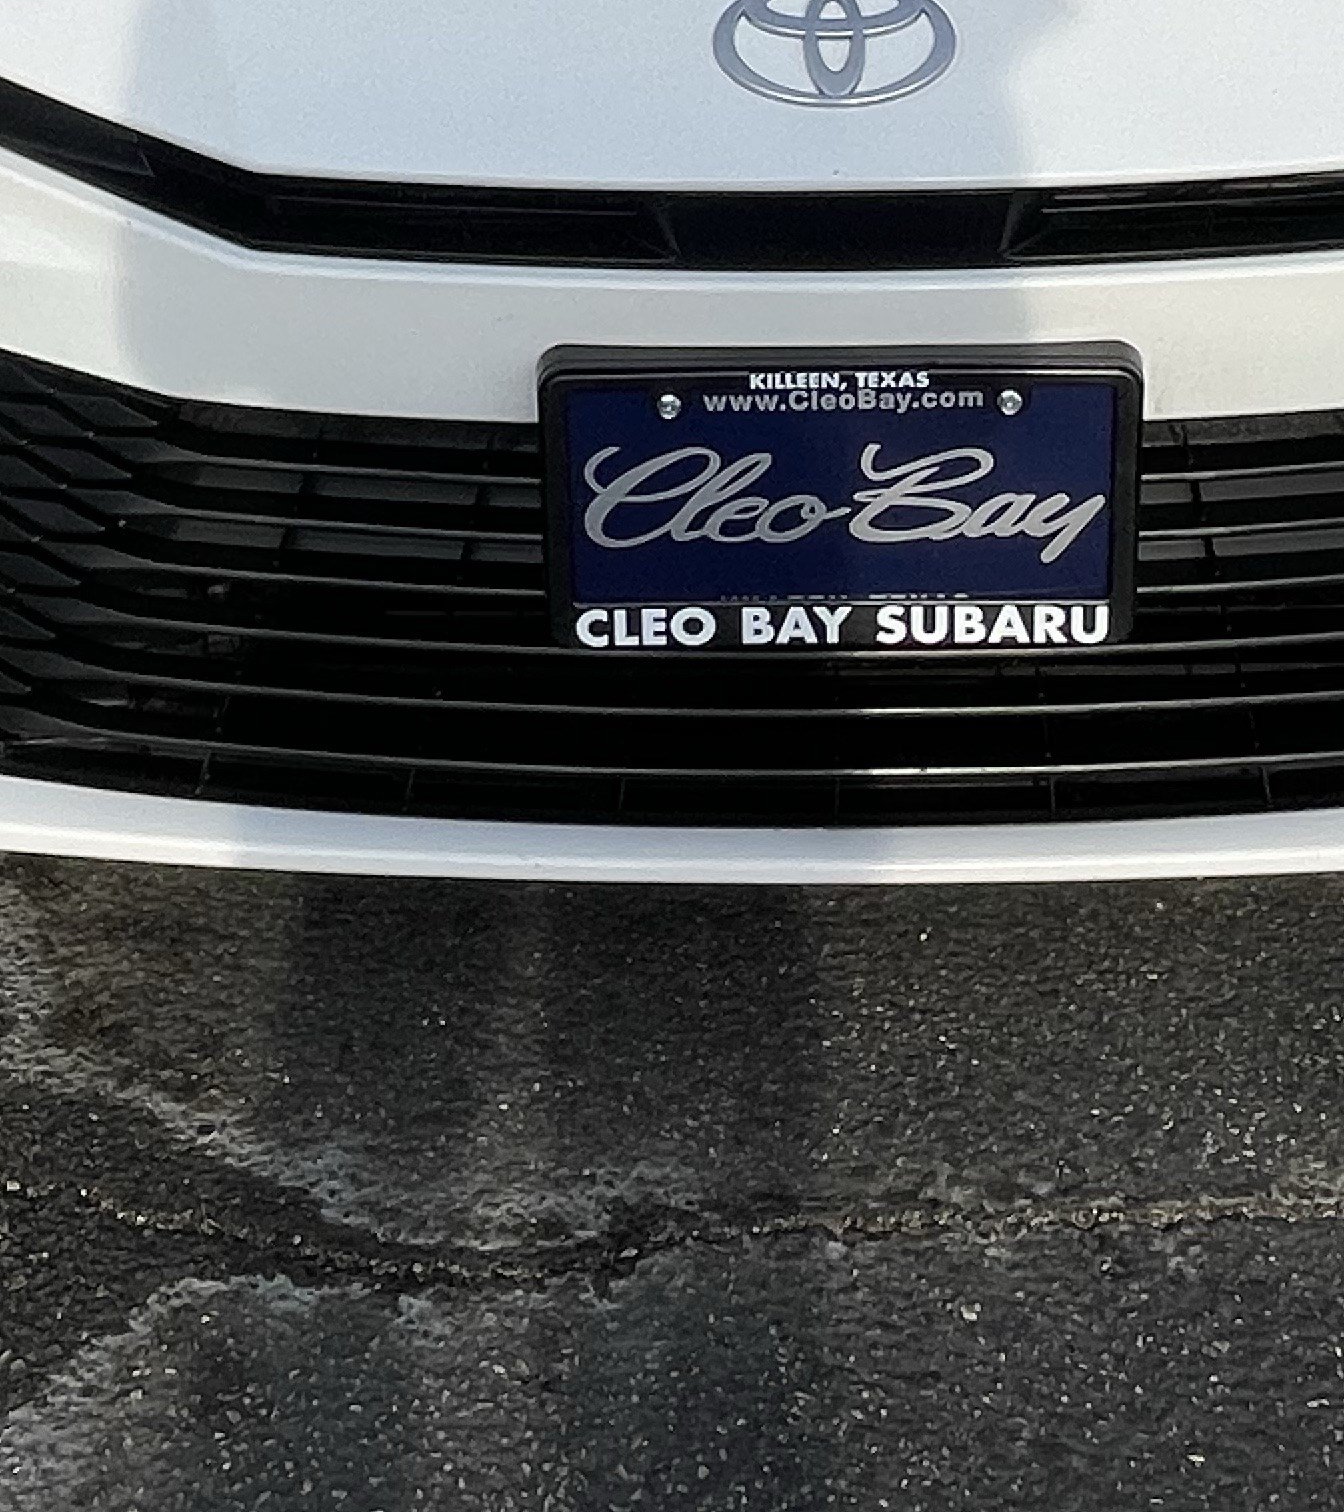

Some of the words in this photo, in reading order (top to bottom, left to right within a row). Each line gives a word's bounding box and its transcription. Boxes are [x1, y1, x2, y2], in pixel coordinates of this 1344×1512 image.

[749, 372, 848, 391] KILLEEN,
[855, 371, 930, 388] TEXAS
[703, 389, 984, 414] www.CleoBay.com
[584, 446, 850, 549] Cleo
[849, 442, 1106, 564] Bay
[575, 608, 717, 648] CLEO
[741, 605, 853, 646] BAY
[876, 603, 1110, 645] SUBARU
